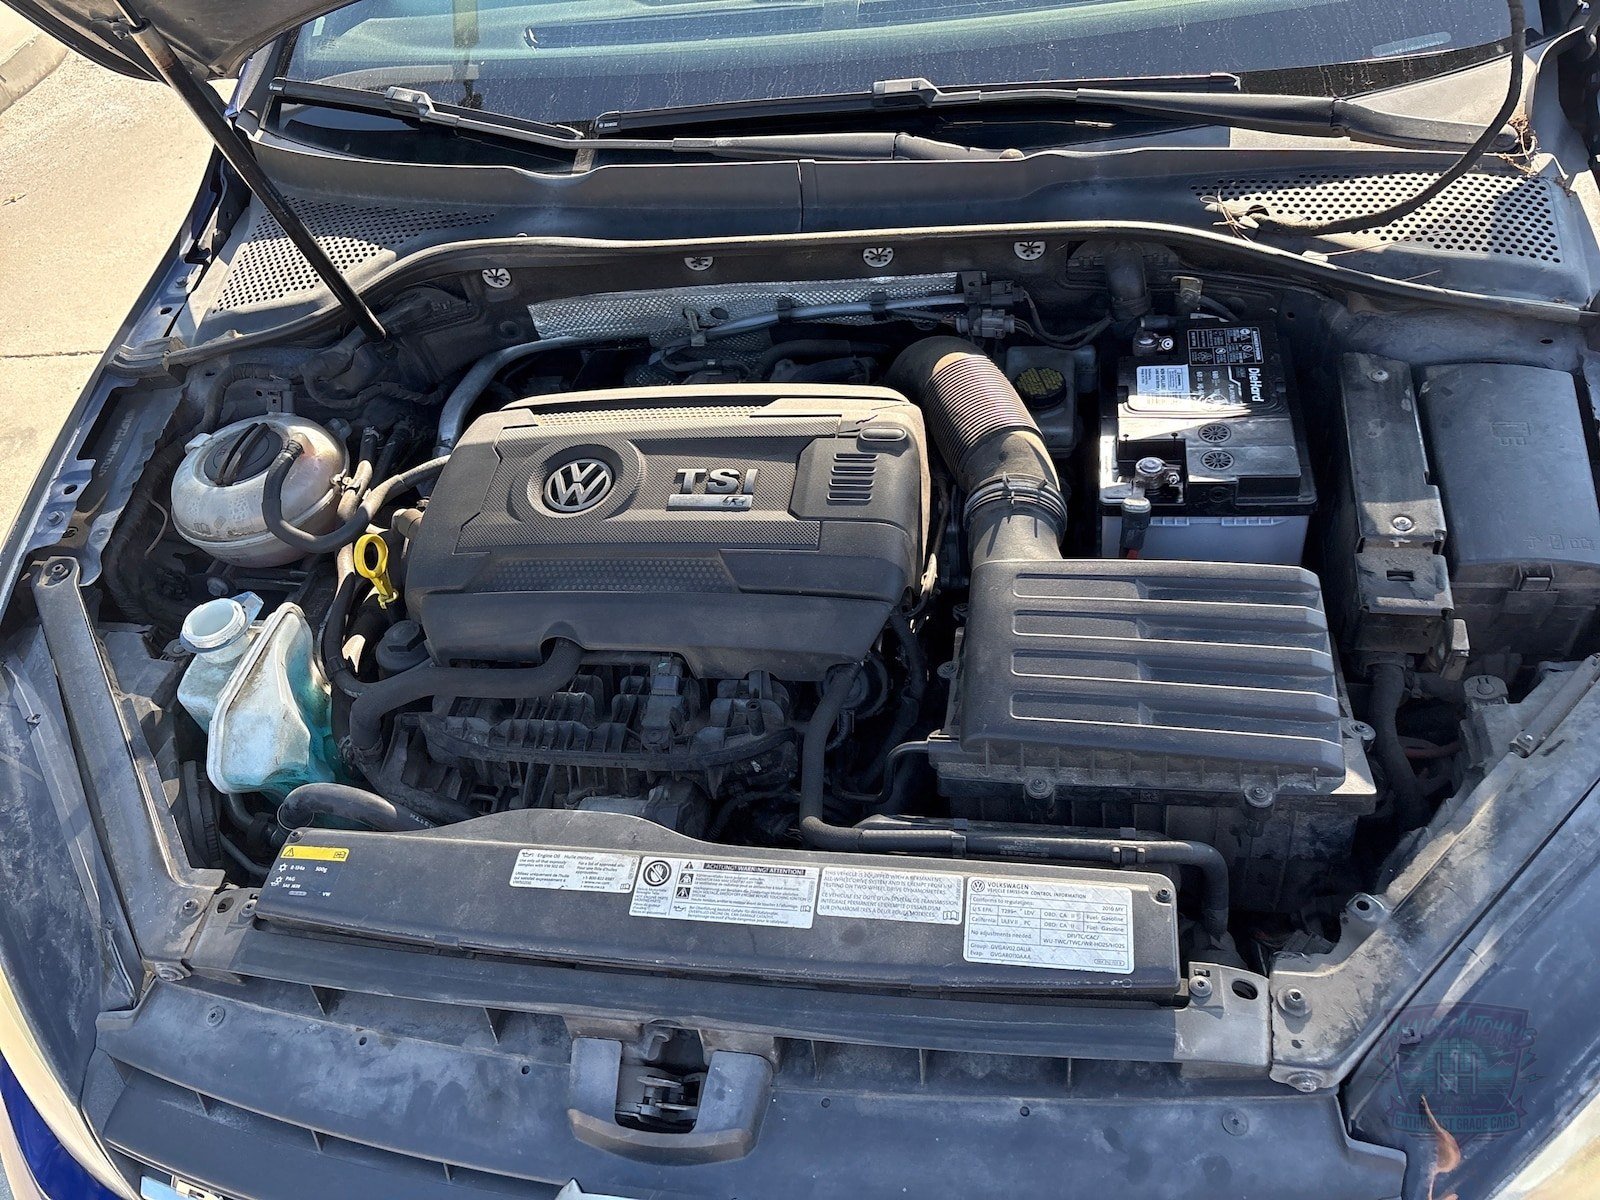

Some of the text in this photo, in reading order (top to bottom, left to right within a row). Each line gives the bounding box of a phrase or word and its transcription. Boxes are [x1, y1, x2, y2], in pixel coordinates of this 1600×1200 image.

[1248, 368, 1264, 402] DieHard
[677, 468, 759, 495] TSI
[988, 882, 1029, 890] VOLKSWAGEN
